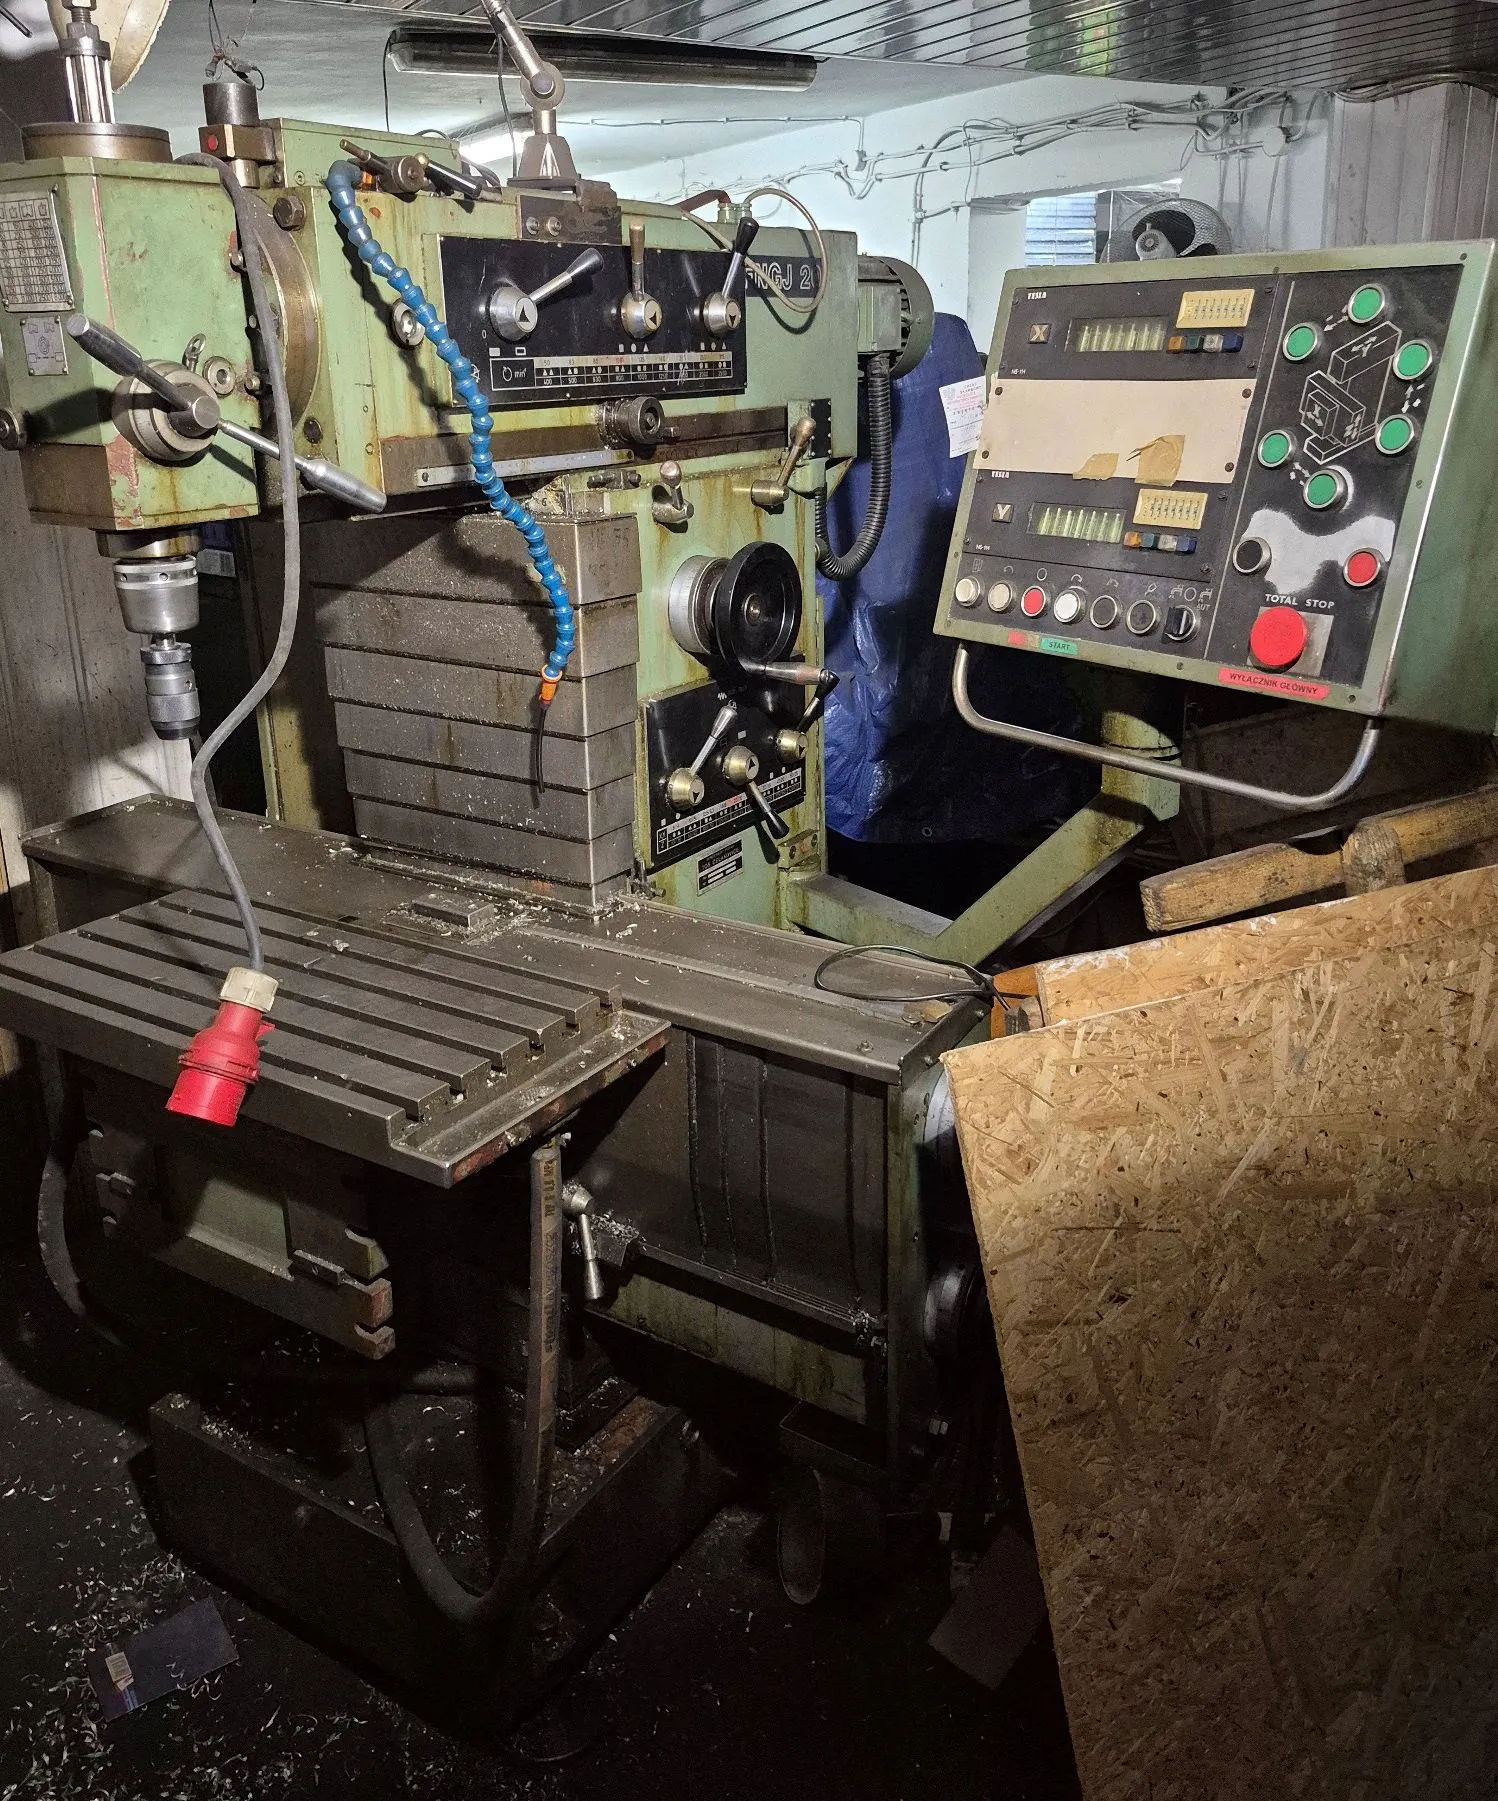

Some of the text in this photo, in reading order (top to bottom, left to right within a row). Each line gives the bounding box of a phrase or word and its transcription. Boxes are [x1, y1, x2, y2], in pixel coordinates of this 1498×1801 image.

[1029, 324, 1049, 341] X
[997, 503, 1011, 520] Y
[1265, 593, 1335, 609] TOTAL STOP
[1048, 641, 1071, 650] START
